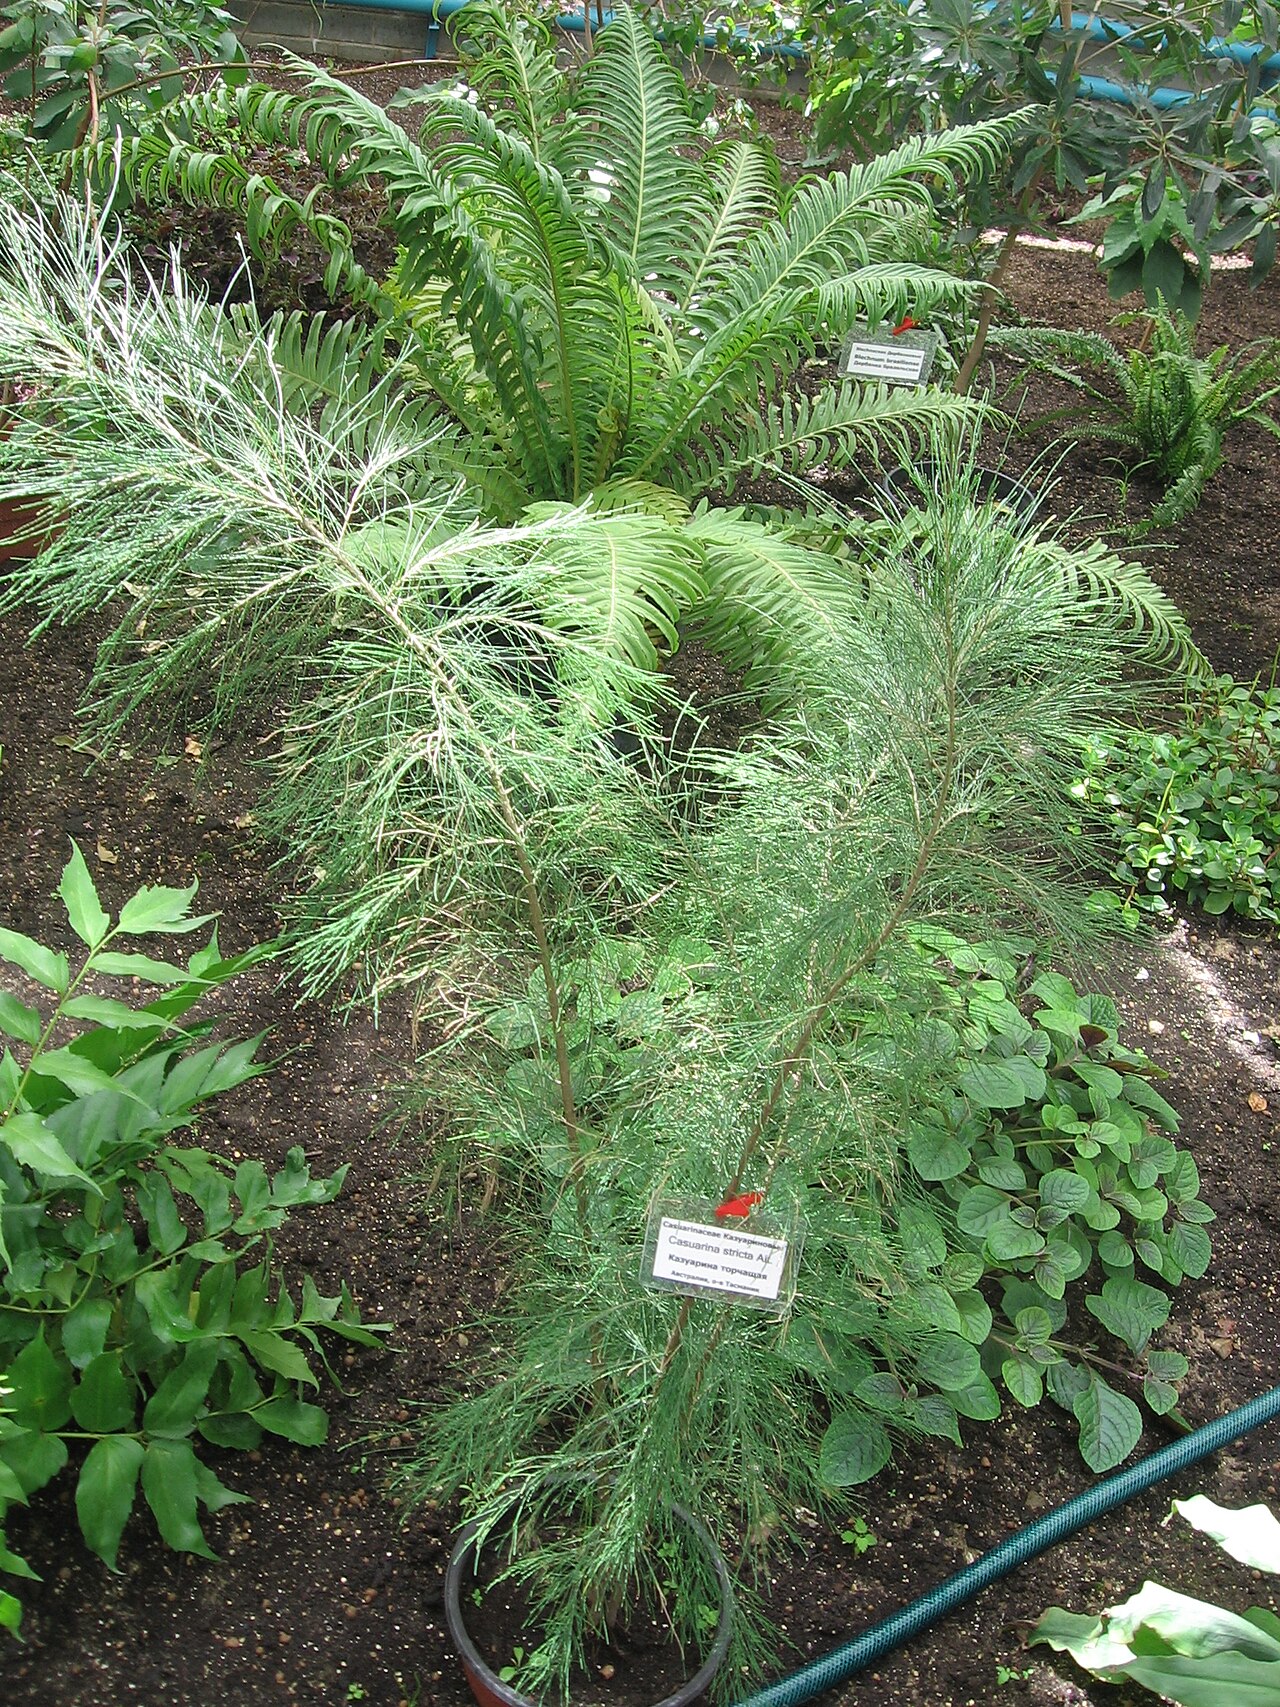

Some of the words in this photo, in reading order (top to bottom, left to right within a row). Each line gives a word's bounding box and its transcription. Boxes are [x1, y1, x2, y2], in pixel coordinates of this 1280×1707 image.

[663, 1221, 721, 1238] Casuarinaceae
[668, 1235, 720, 1254] Casuarina
[723, 1247, 754, 1260] stricta
[668, 1254, 718, 1270] Казуарина
[721, 1265, 767, 1280] торчащая
